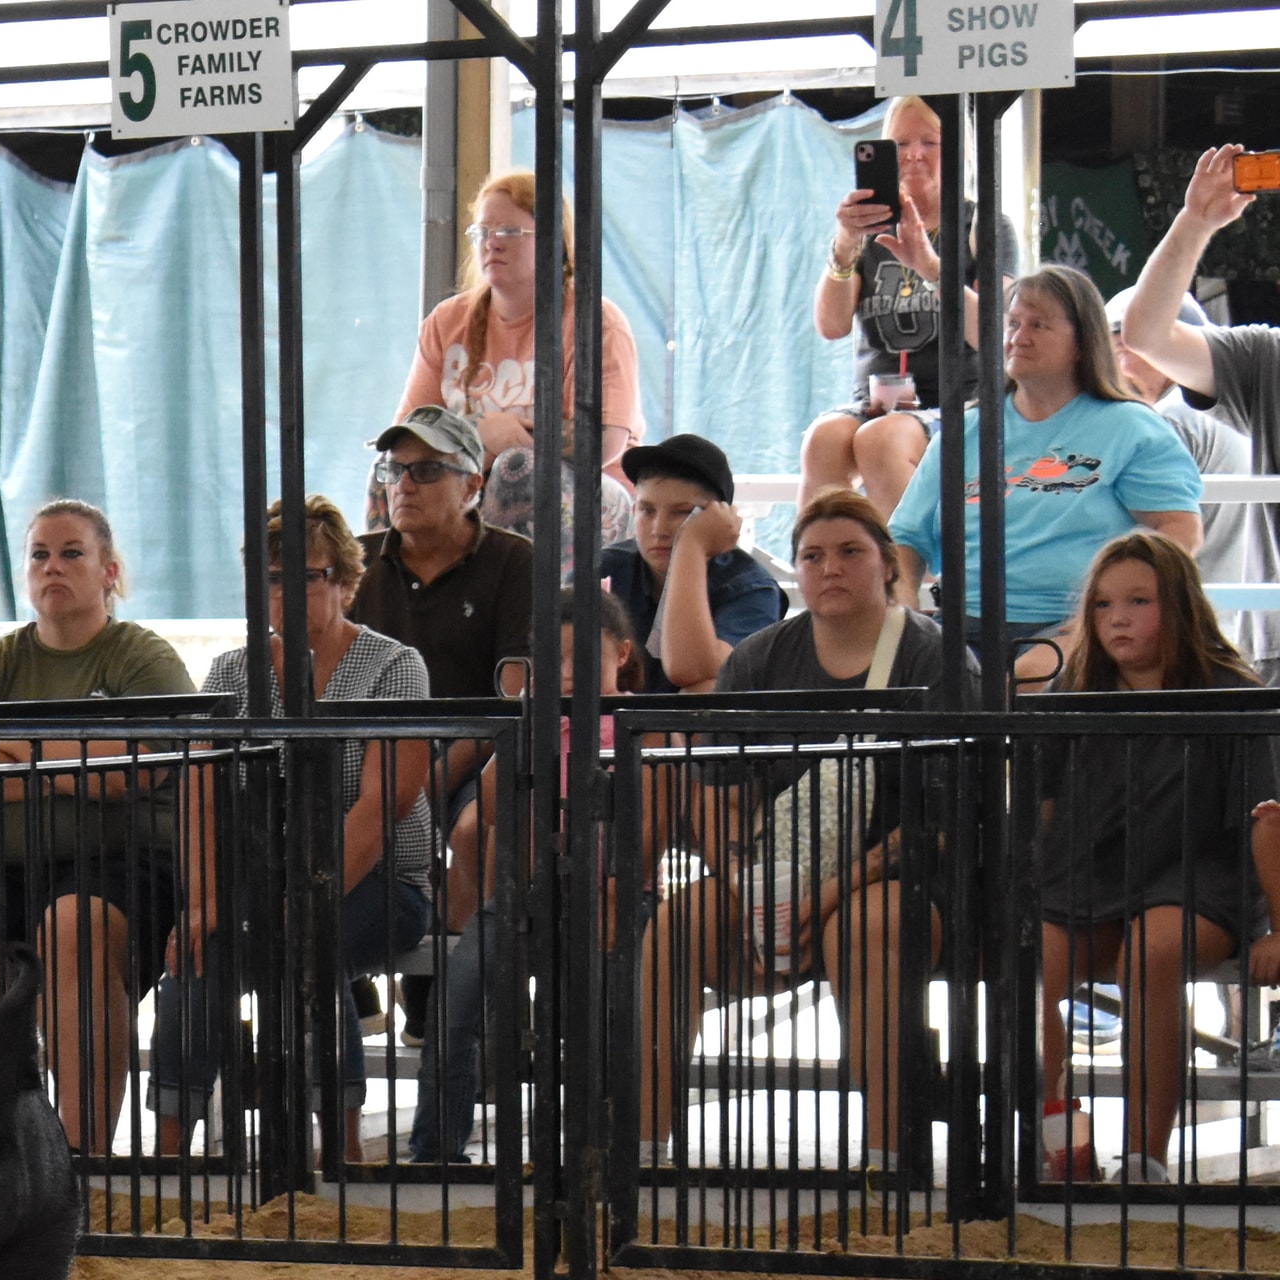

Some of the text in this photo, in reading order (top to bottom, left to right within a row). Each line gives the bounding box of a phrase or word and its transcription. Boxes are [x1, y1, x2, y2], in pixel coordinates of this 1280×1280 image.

[156, 17, 280, 45] CROWDER
[947, 3, 1038, 32] SHOW
[881, 0, 923, 76] 4
[177, 50, 262, 76] FAMILY
[958, 41, 1028, 69] PIGS
[119, 19, 156, 122] 5
[180, 83, 262, 108] FARMS
